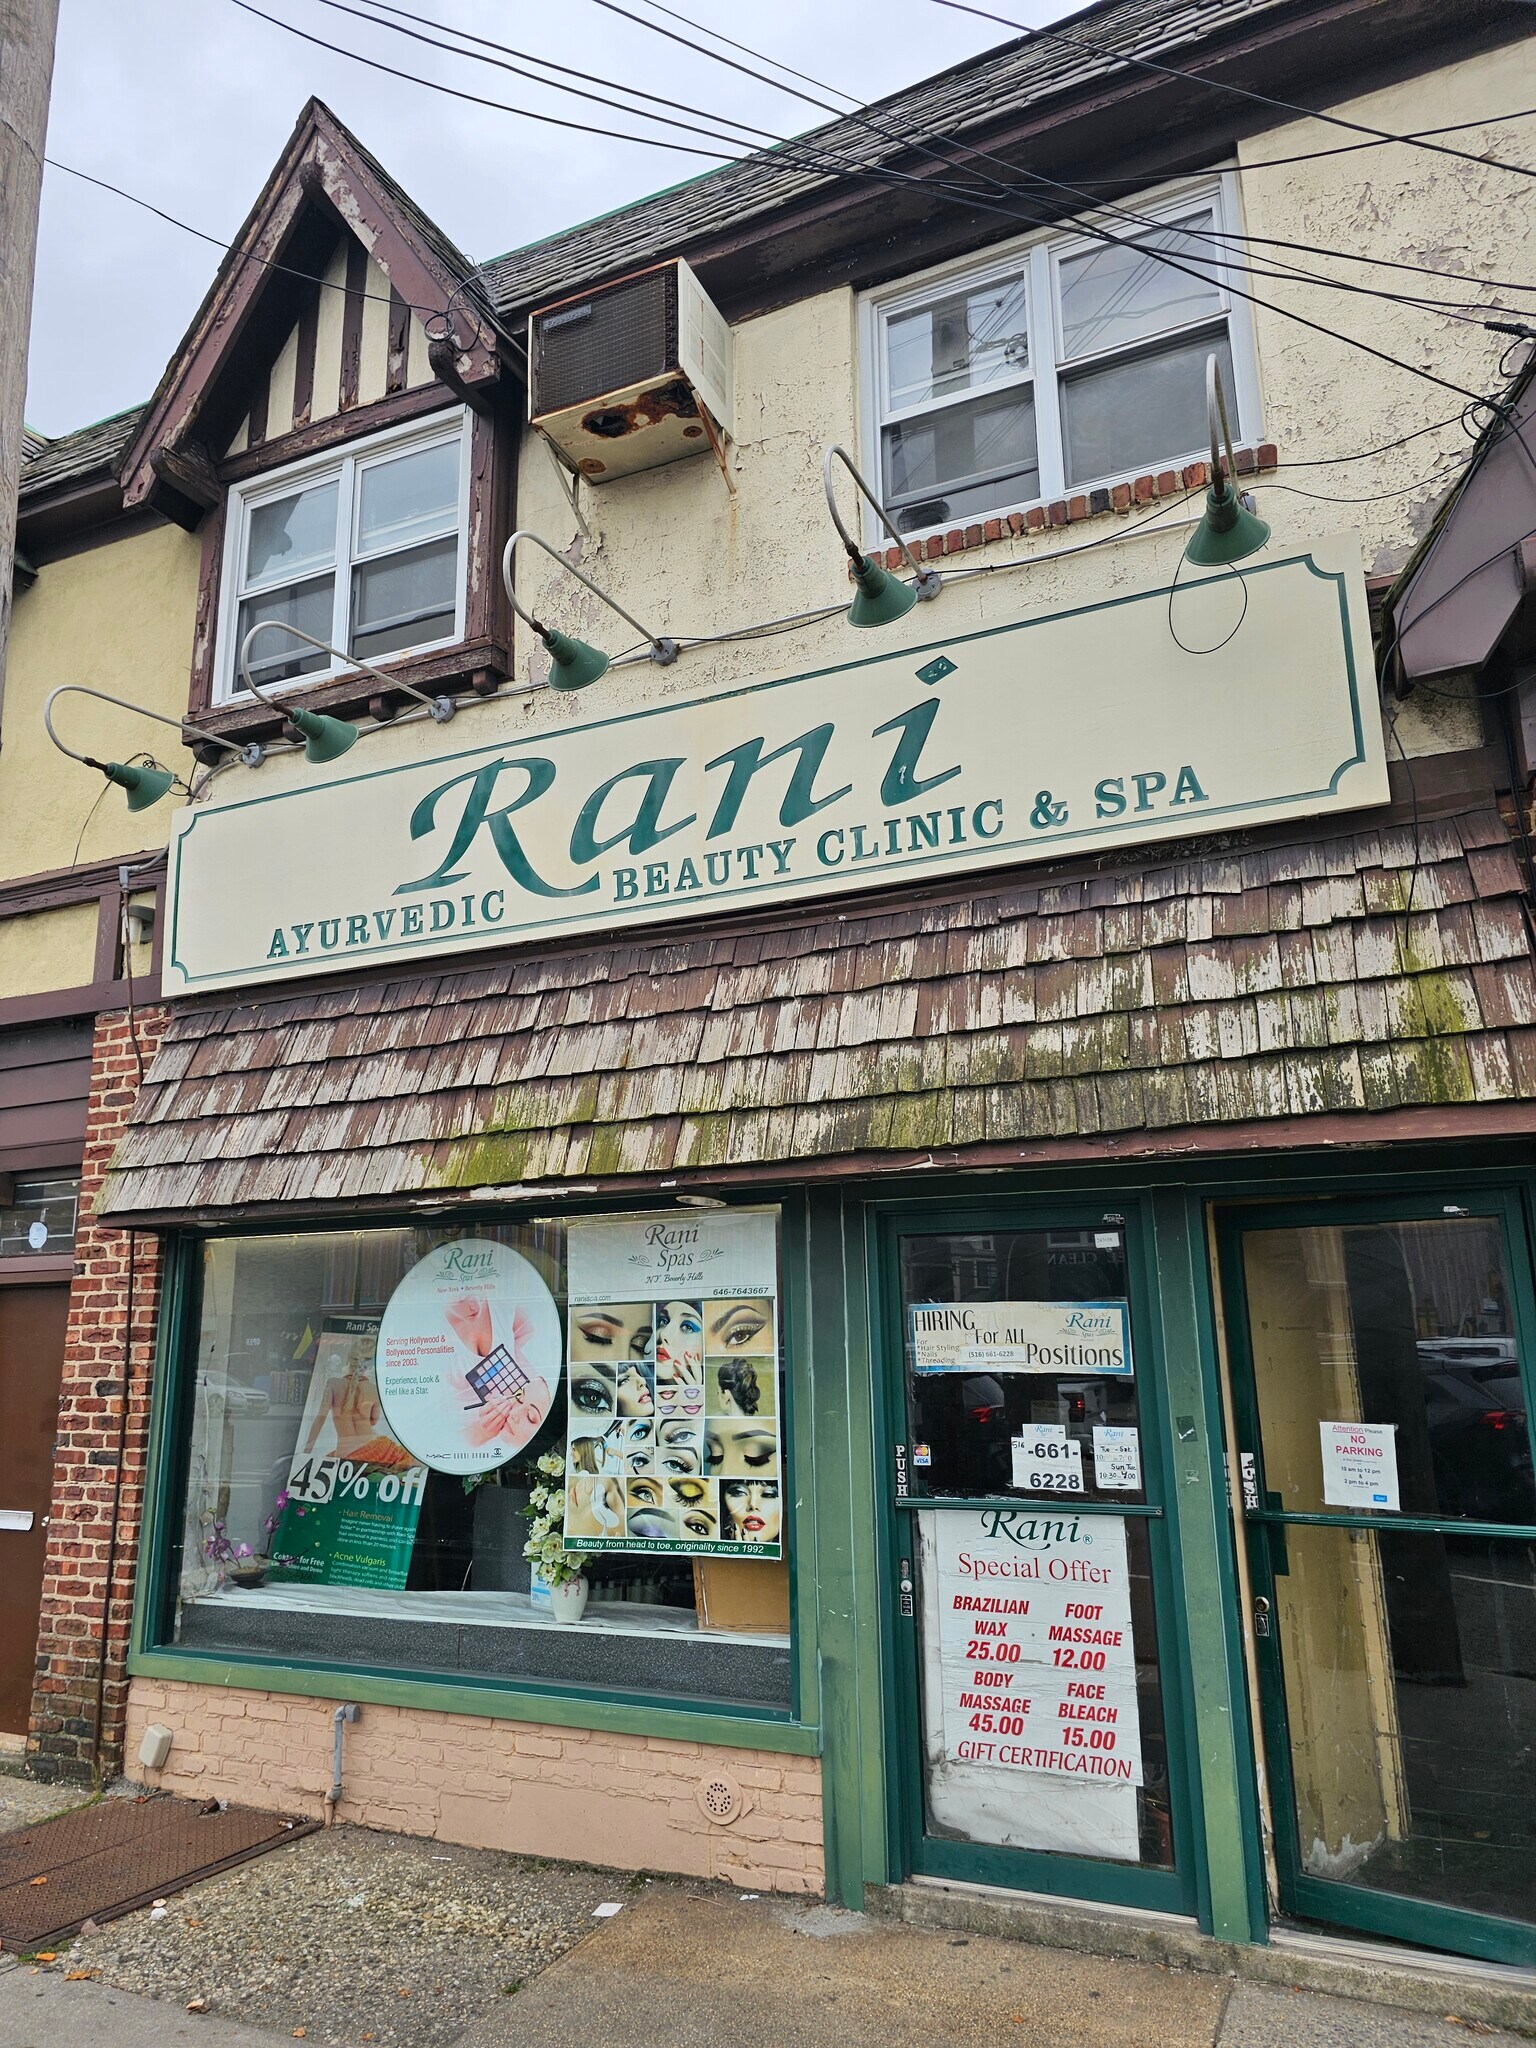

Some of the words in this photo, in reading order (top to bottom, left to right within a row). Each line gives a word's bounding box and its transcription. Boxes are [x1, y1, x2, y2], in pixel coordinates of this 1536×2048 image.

[392, 656, 962, 898] Rani
[267, 890, 504, 959] AYURVEDIC
[613, 838, 797, 902] BEAUTY
[817, 799, 1003, 866] CLINIC
[1030, 790, 1068, 829] &
[1094, 765, 1209, 819] SPA
[645, 1223, 699, 1250] Rani
[444, 1247, 494, 1274] Rani
[657, 1249, 694, 1271] Spas
[713, 1287, 769, 1296] 646-7643667
[346, 1321, 366, 1331] Rani
[914, 1310, 976, 1331] HIRING
[1065, 1312, 1112, 1332] Rani
[386, 1337, 408, 1346] Serving
[409, 1336, 440, 1345] Hollywood
[976, 1328, 998, 1344] For
[1005, 1328, 1027, 1344] ALL
[386, 1347, 416, 1357] Bollywood
[417, 1345, 455, 1355] Personalities
[937, 1344, 960, 1352] Styling
[1027, 1343, 1123, 1366] Positions
[386, 1359, 401, 1367] since
[402, 1358, 418, 1367] 2003.
[385, 1376, 418, 1385] Experience,
[419, 1375, 434, 1383] Look
[385, 1387, 397, 1395] Feel
[399, 1386, 409, 1395] like
[1034, 1425, 1053, 1434] Rani
[1103, 1428, 1124, 1438] Rani
[1332, 1425, 1364, 1433] Attention
[1350, 1435, 1366, 1444] NO
[1336, 1446, 1383, 1457] PARKING
[289, 1457, 370, 1500] 45%
[895, 1445, 908, 1497] PUSH
[1030, 1473, 1080, 1489] 6228
[342, 1509, 359, 1518] Hair
[360, 1511, 394, 1522] Removal
[576, 1539, 604, 1550] Beauty
[605, 1540, 625, 1548] from
[626, 1540, 646, 1549] head
[648, 1541, 655, 1549] to
[657, 1541, 673, 1551] toe,
[675, 1542, 716, 1553] originality
[717, 1544, 739, 1552] since
[742, 1544, 764, 1554] 1992
[299, 1555, 310, 1564] for
[310, 1557, 325, 1566] Free
[333, 1551, 354, 1562] Acne
[355, 1554, 386, 1566] Vulgaris
[958, 1552, 1041, 1582] Special
[1048, 1558, 1112, 1584] Offer
[952, 1595, 1029, 1615] BRAZILIAN
[1065, 1603, 1103, 1620] FOOT
[974, 1620, 1008, 1637] WAX
[1048, 1626, 1123, 1646] MASSAGE
[965, 1640, 1021, 1663] 25.00
[1052, 1648, 1106, 1671] 12.00
[973, 1671, 1014, 1689] BODY
[1067, 1683, 1105, 1700] FACE
[959, 1693, 1031, 1714] MASSAGE
[1057, 1703, 1118, 1724] BLEACH
[968, 1713, 1024, 1736] 45.00
[1062, 1727, 1116, 1750] 15.00
[957, 1741, 997, 1761] GIFT
[999, 1745, 1132, 1779] CERTIFICATION
